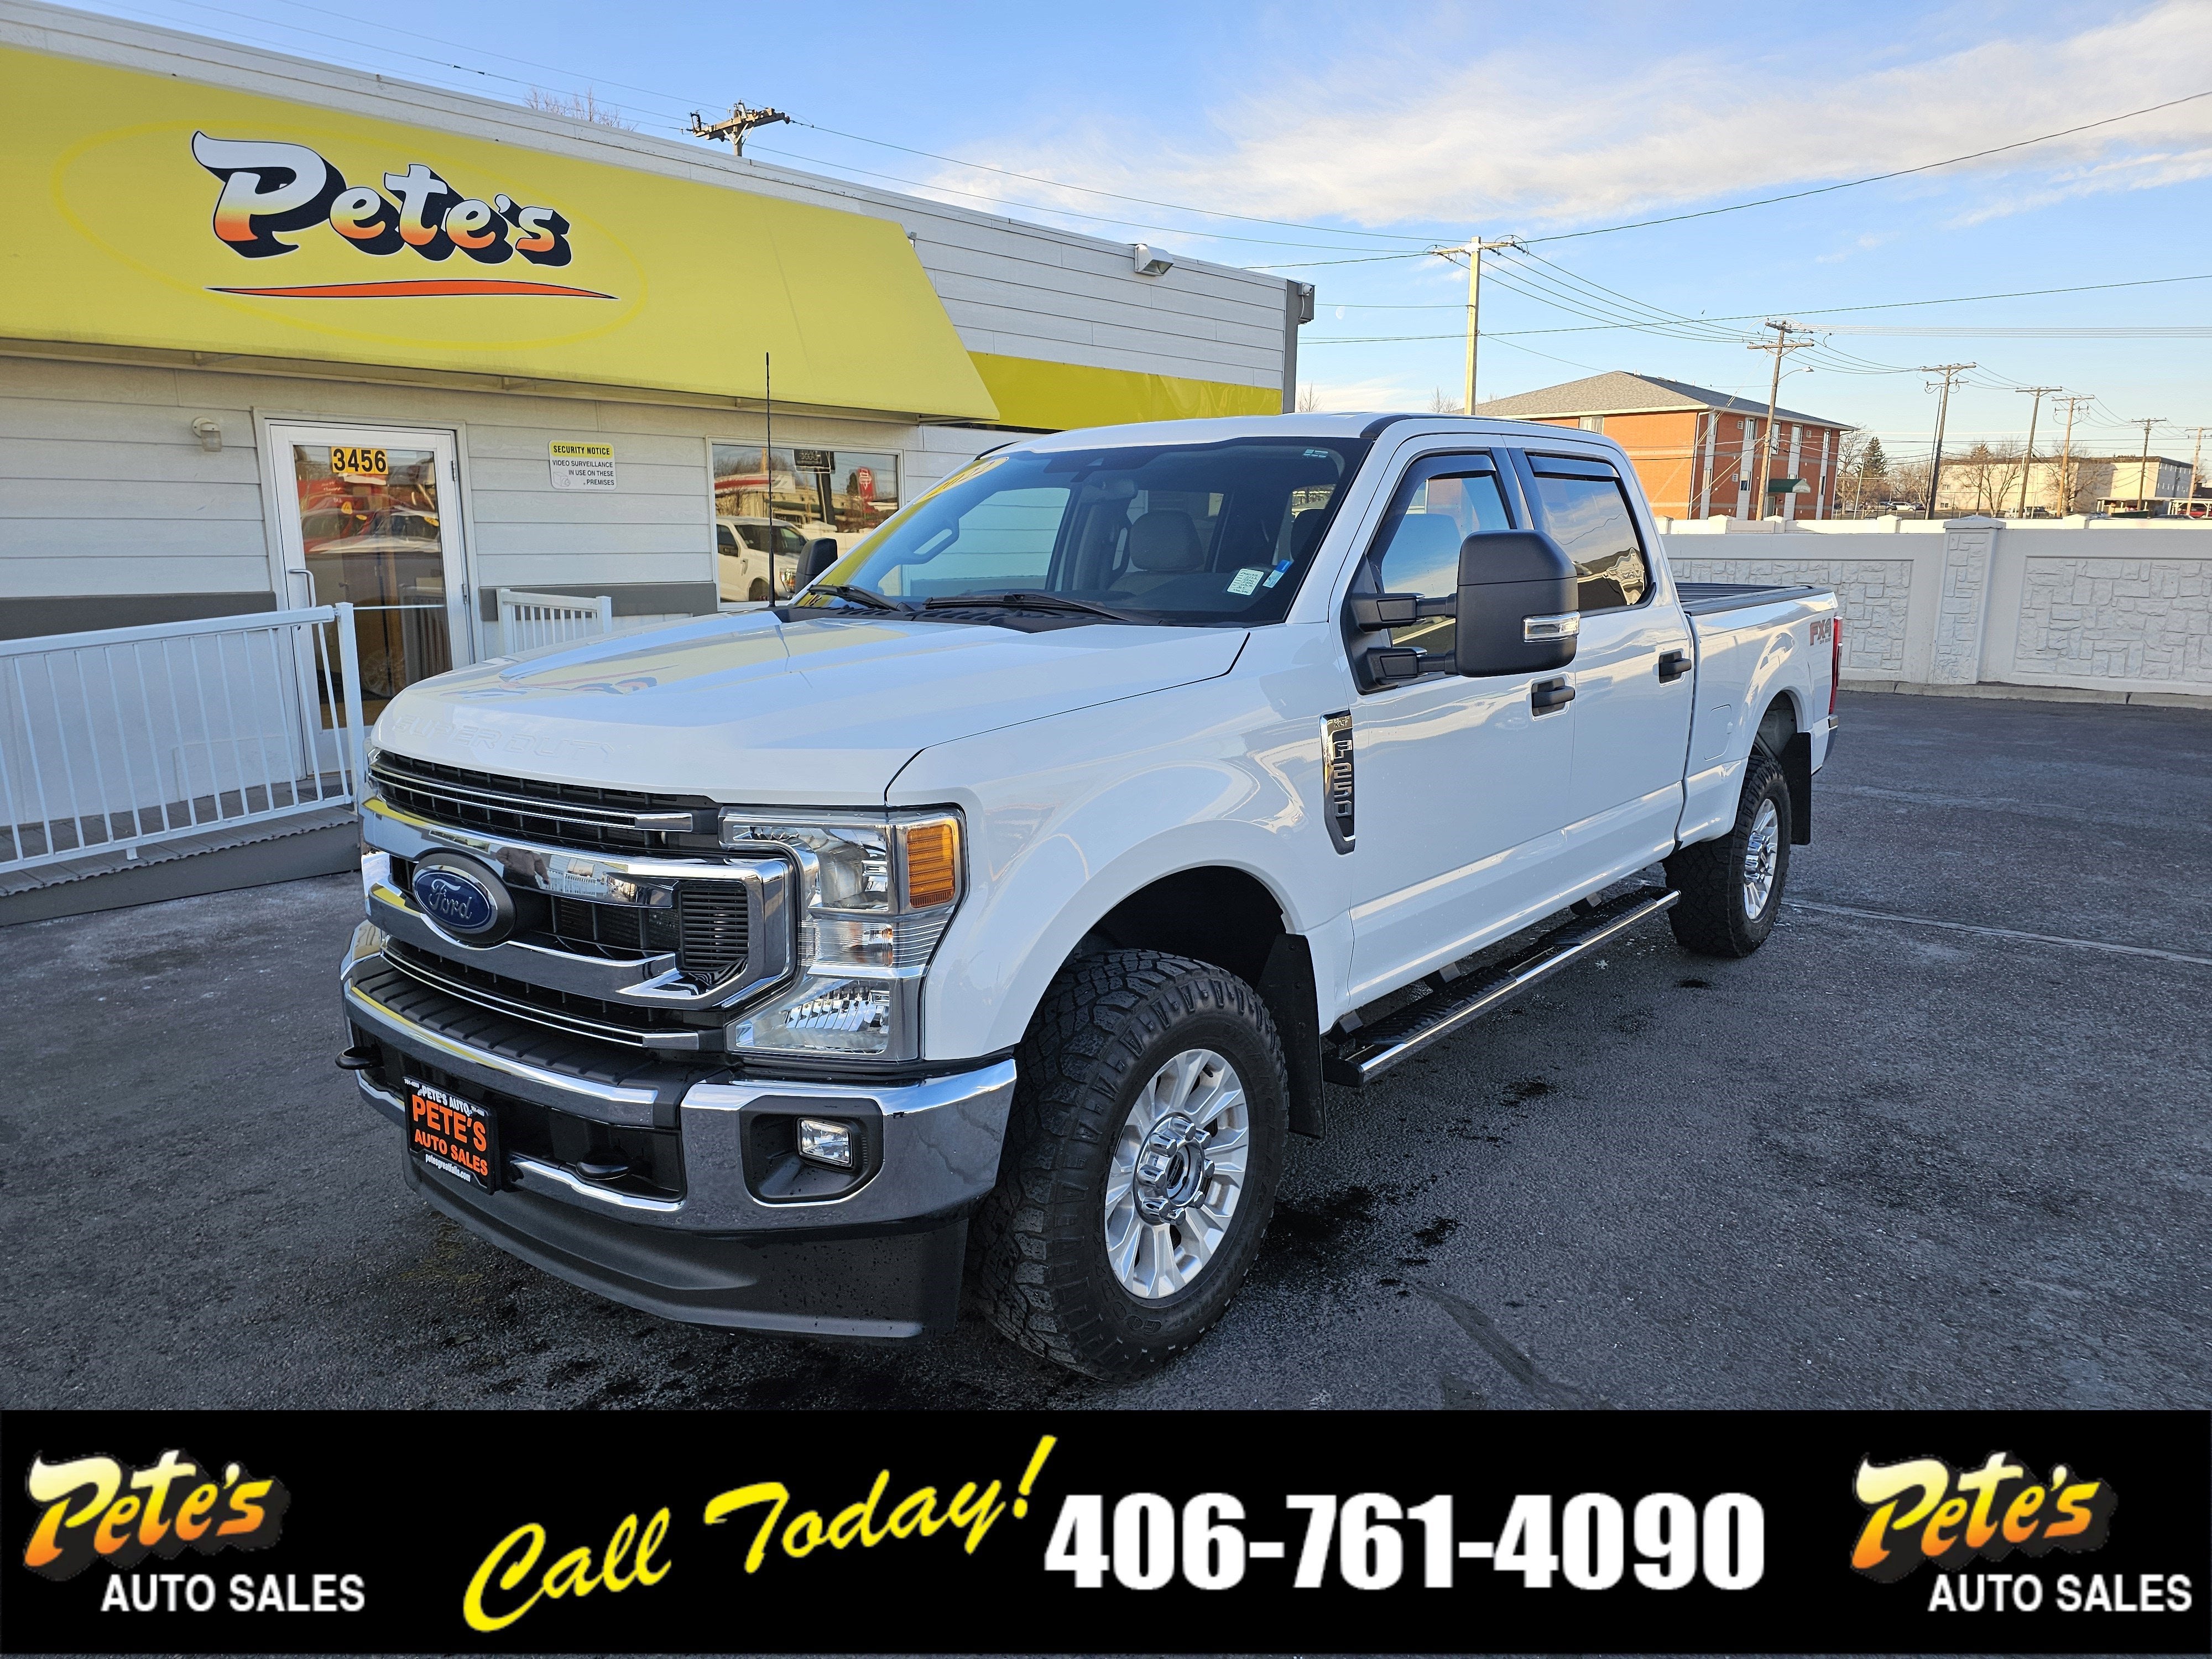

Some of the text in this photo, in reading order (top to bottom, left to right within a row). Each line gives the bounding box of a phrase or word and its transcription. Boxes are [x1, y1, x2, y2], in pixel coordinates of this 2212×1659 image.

[192, 131, 572, 267] Pete's
[333, 448, 386, 472] 3456
[554, 445, 585, 453] SECURITY
[1810, 618, 1831, 646] FX4
[392, 714, 614, 763] SUPER DUTY
[1334, 719, 1348, 728] XLT
[428, 879, 472, 919] Ford
[421, 1084, 471, 1117] PETE'S AUTO
[412, 1094, 487, 1151] PETE'S
[415, 1129, 488, 1176] AUTO SALES
